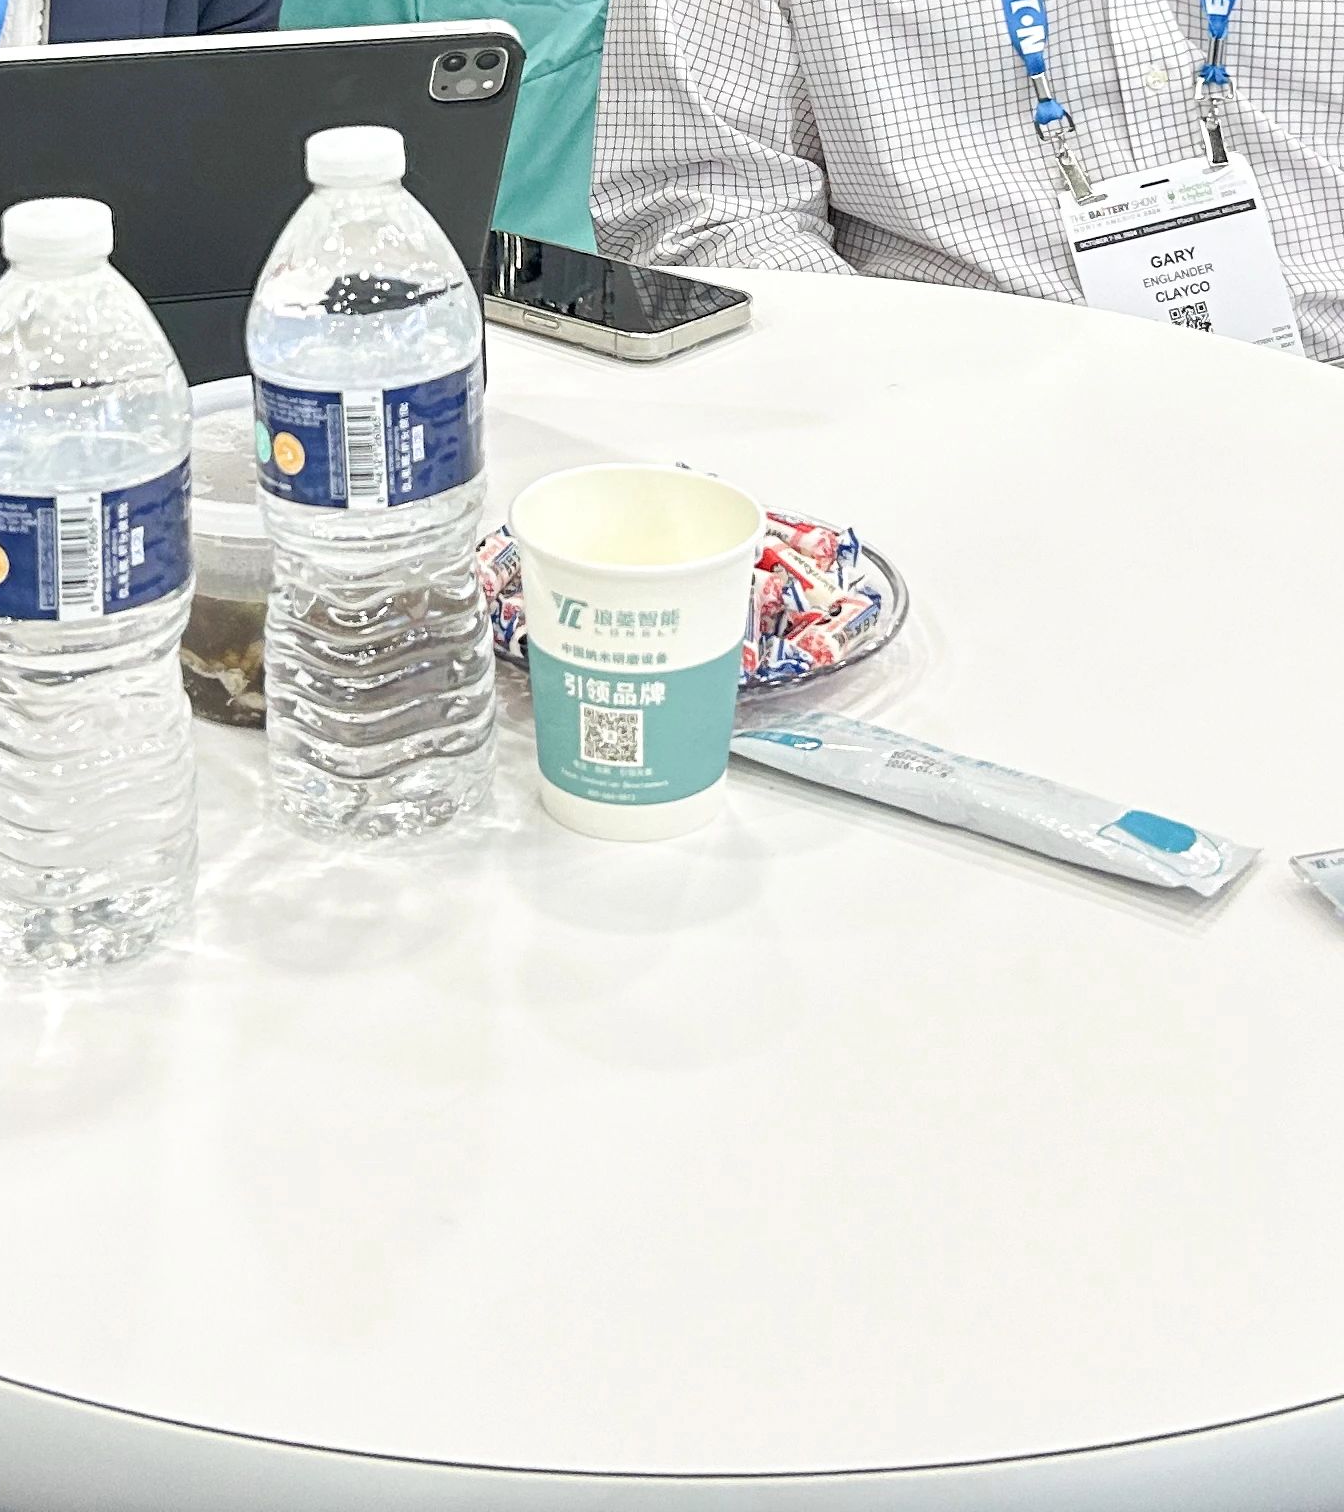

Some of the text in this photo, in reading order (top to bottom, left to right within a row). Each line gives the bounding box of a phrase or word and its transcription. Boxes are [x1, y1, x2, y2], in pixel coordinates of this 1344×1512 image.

[1070, 211, 1087, 224] THE
[1088, 201, 1130, 220] BATTERY
[1130, 195, 1158, 209] SHOW
[1150, 246, 1195, 268] GARY
[1143, 262, 1215, 288] ENGLANDER
[1155, 280, 1210, 303] CLAYCO
[563, 671, 666, 706] 引领品牌
